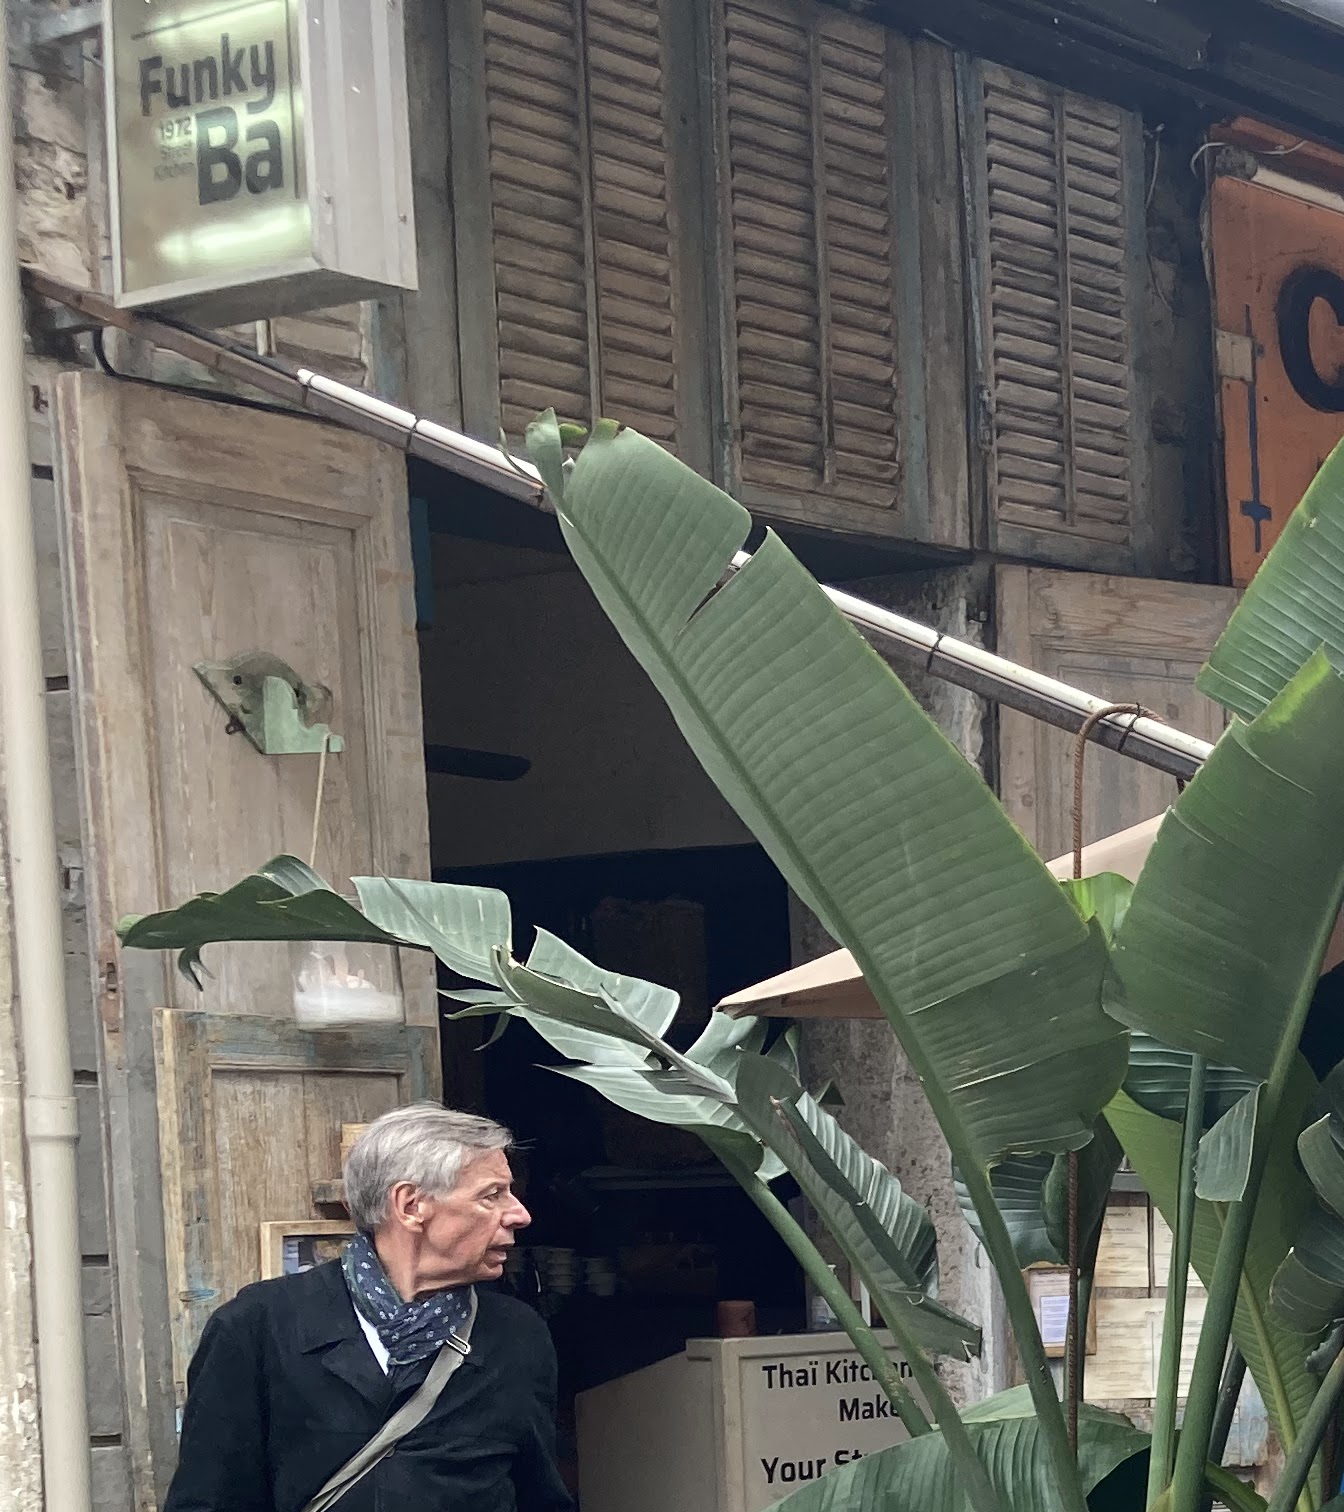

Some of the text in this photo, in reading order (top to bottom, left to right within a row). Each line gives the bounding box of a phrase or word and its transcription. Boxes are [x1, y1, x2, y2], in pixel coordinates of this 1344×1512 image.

[138, 33, 276, 117] Funky
[195, 106, 284, 206] Ba
[762, 1357, 914, 1389] Thaï Kitcn
[839, 1394, 903, 1422] Make
[761, 1455, 826, 1485] Your
